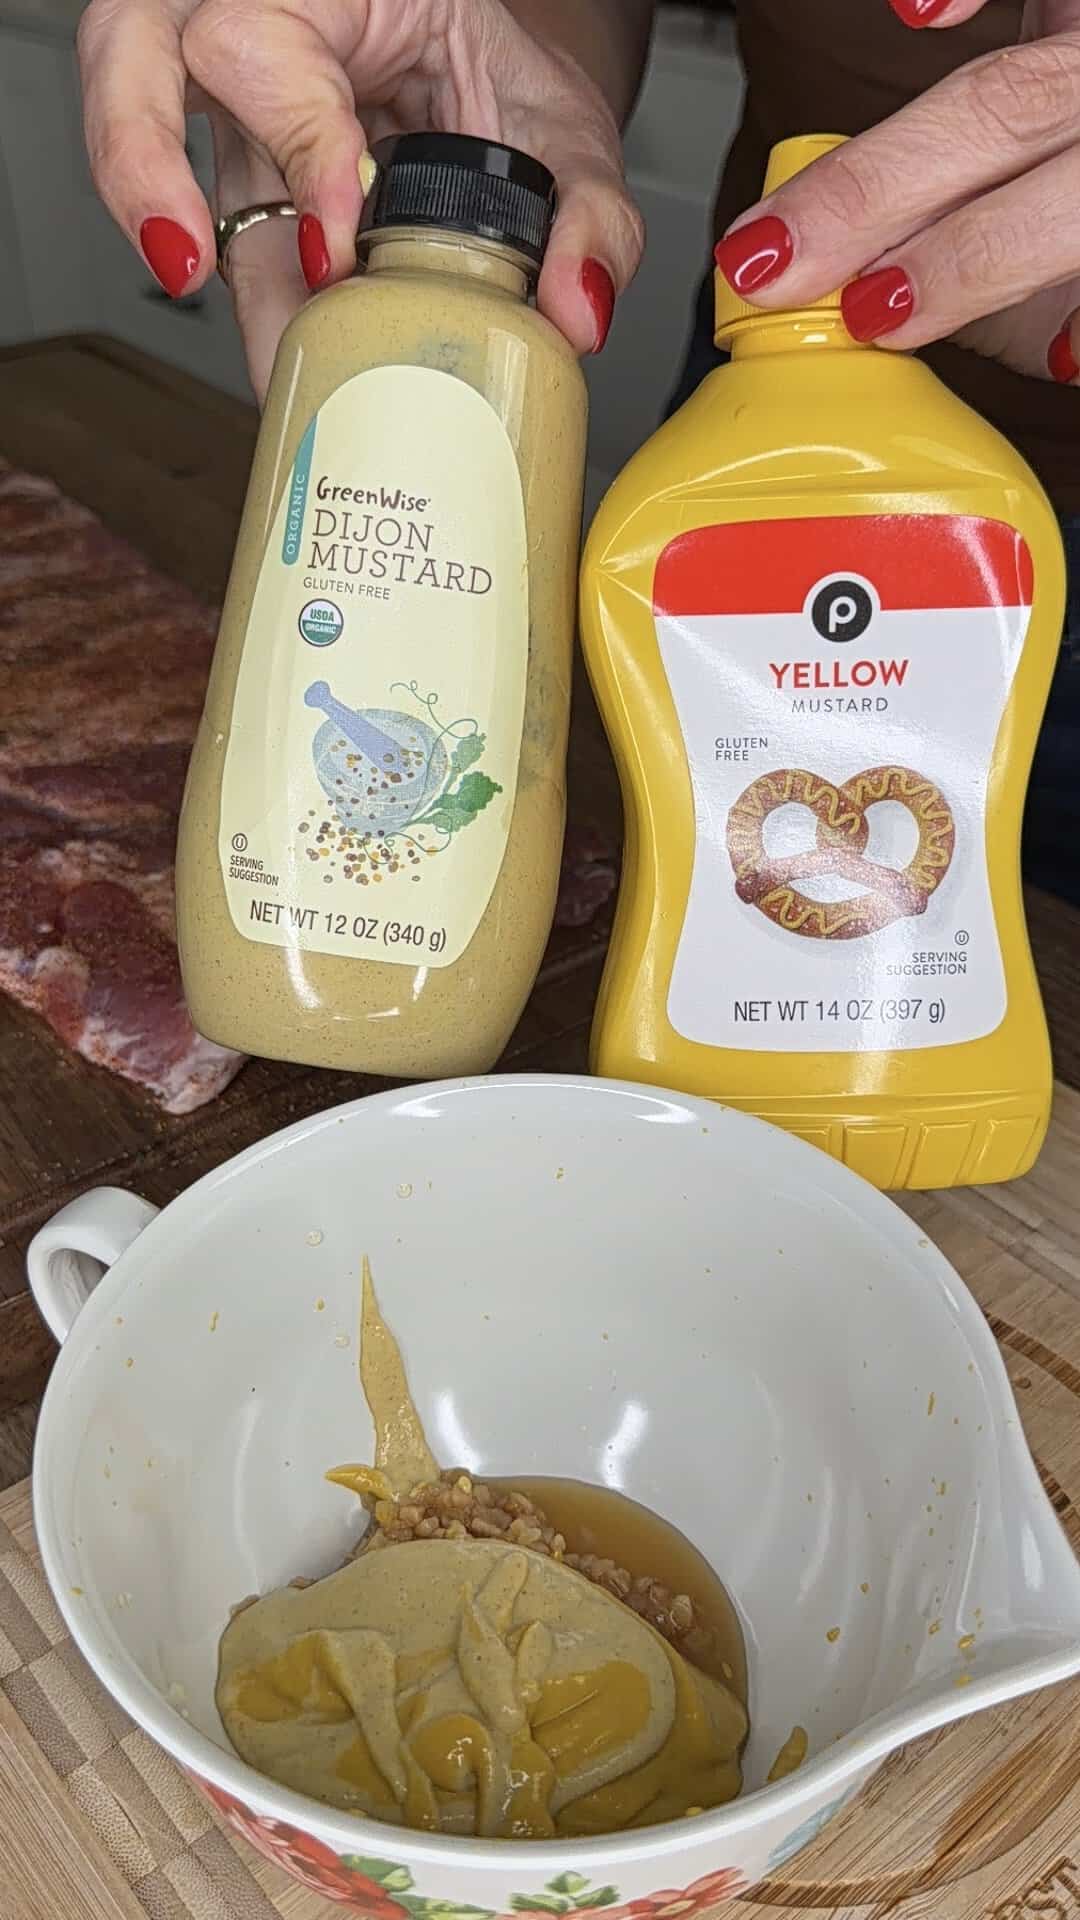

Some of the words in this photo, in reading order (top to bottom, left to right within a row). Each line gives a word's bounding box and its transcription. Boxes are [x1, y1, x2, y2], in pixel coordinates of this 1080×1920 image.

[316, 475, 430, 513] GreenWise
[286, 474, 306, 555] ORGANIC
[312, 508, 434, 553] DIJON
[307, 541, 492, 595] MUSTARD
[303, 577, 355, 594] GLUTEN
[358, 584, 391, 600] FREE
[310, 607, 335, 623] USDA
[304, 622, 337, 635] ORGANIC
[769, 659, 909, 689] YELLOW
[791, 697, 889, 714] MUSTARD
[714, 737, 769, 750] GLUTEN
[714, 750, 750, 761] FREE
[230, 855, 264, 871] SERVING
[229, 867, 279, 887] SUGGESTION
[250, 899, 285, 926] NET
[290, 906, 319, 931] WT
[325, 912, 347, 935] 12
[352, 916, 379, 940] OZ
[383, 921, 425, 947] (340
[428, 927, 448, 953] g)
[911, 951, 968, 964] SERVING
[886, 963, 967, 976] SUGGESTION
[734, 1001, 772, 1022] NET
[777, 1000, 809, 1022] WT
[815, 1000, 841, 1021] 14
[846, 999, 874, 1021] OZ
[879, 999, 923, 1024] (397
[928, 999, 946, 1024] g)
